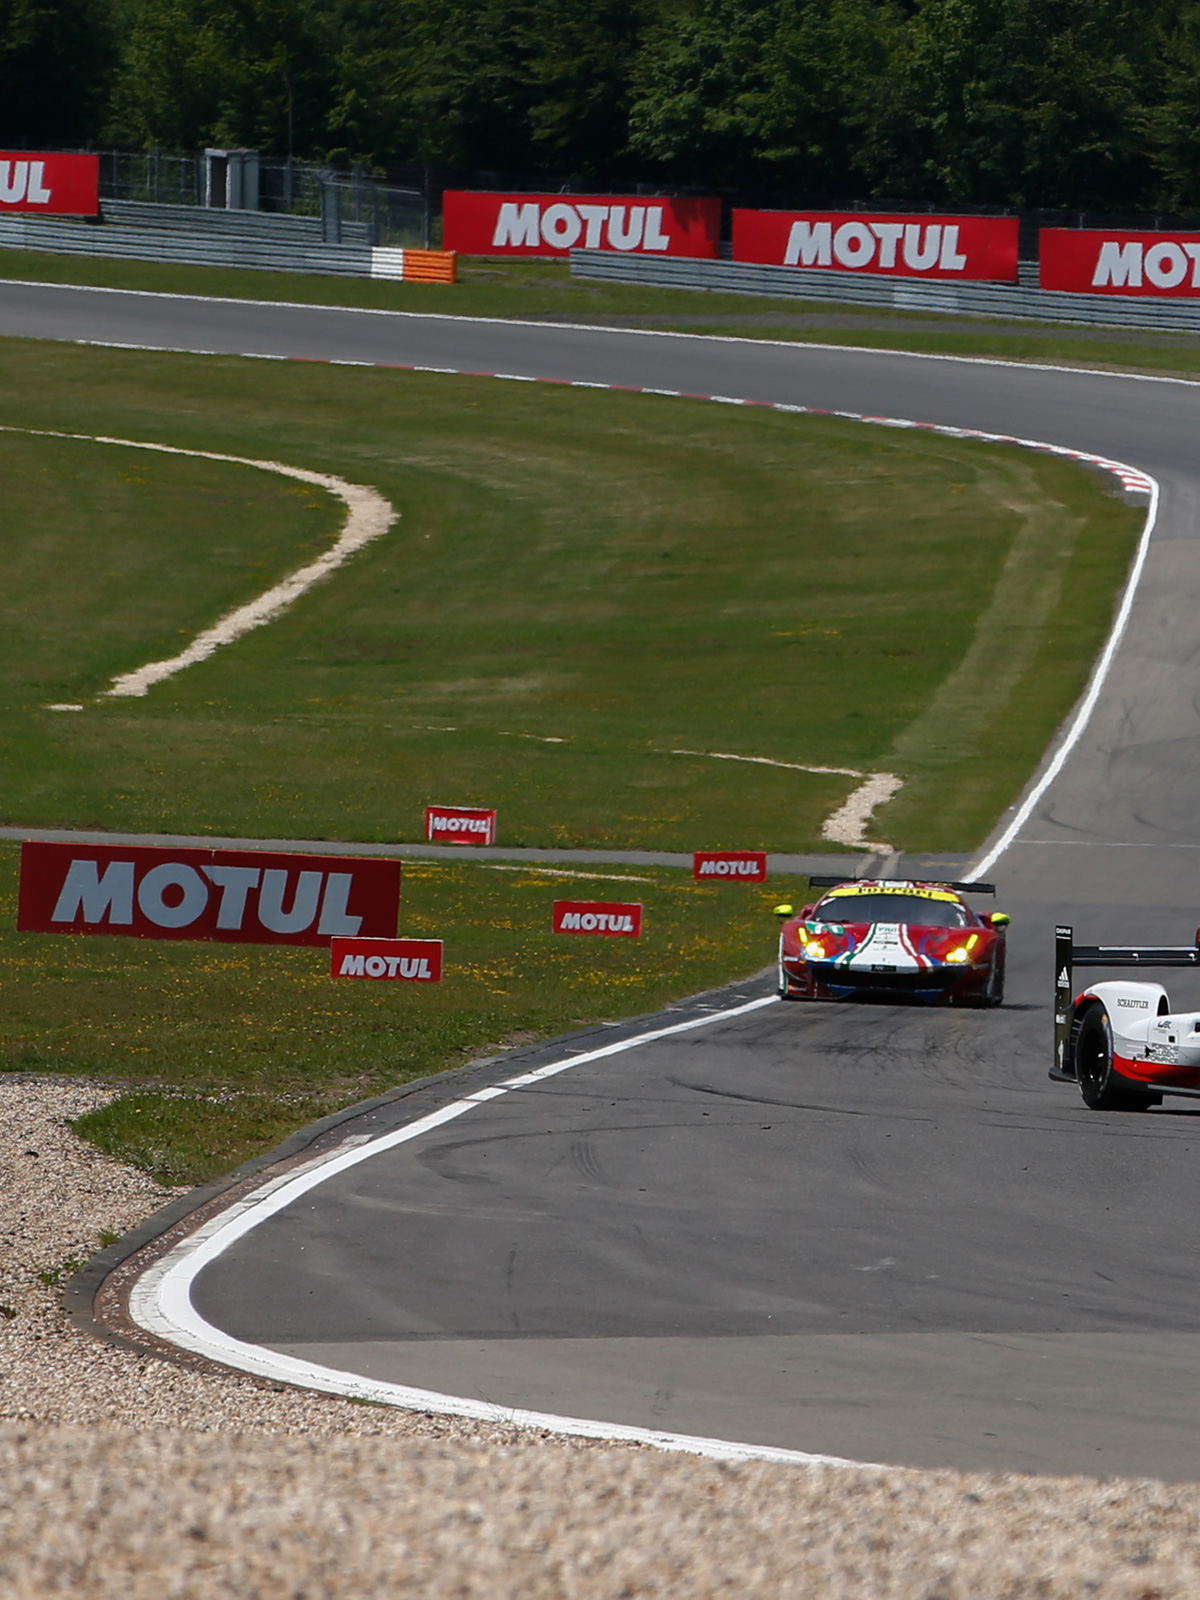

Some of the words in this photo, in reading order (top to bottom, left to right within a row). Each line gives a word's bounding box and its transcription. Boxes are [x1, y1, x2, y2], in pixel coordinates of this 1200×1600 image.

[493, 203, 670, 252] MOTUL
[784, 221, 968, 272] MOTUL
[433, 816, 489, 833] MOTUL
[699, 859, 761, 876] MOTUL
[52, 859, 364, 937] MOTUL
[560, 911, 634, 933] MOTUL
[339, 954, 432, 979] MOTUL
